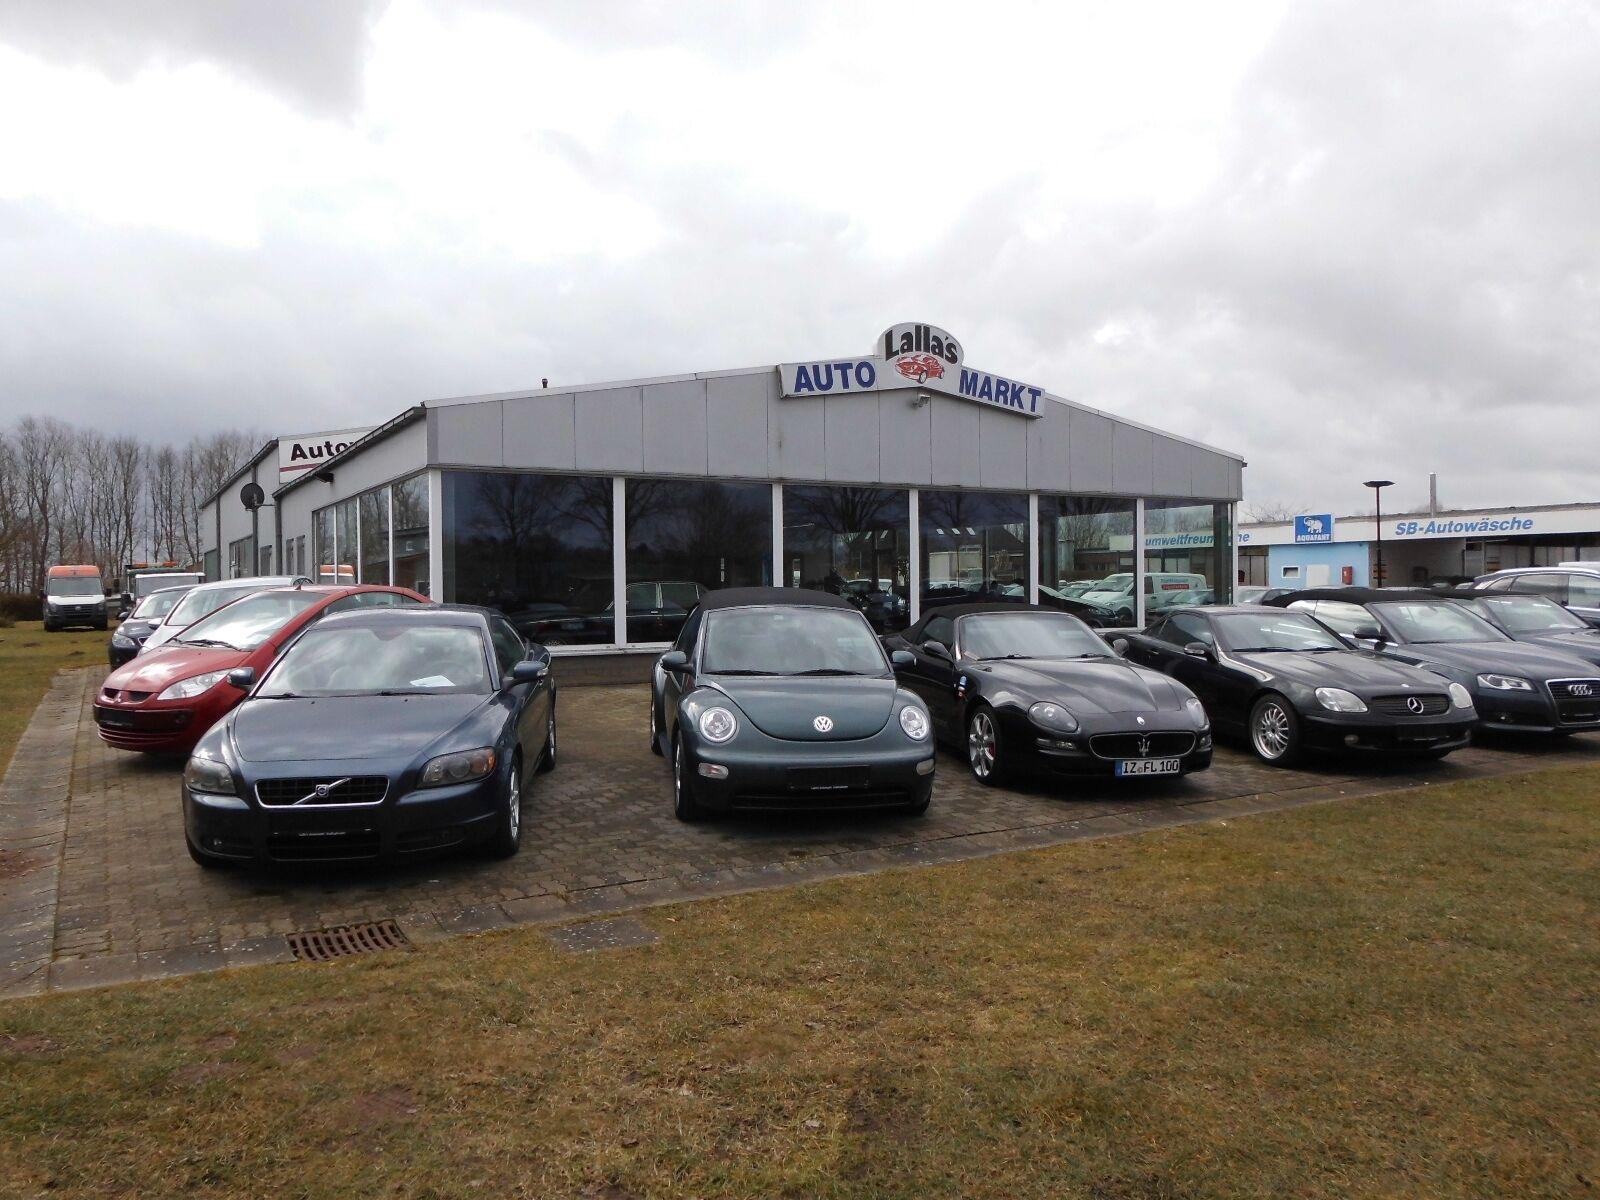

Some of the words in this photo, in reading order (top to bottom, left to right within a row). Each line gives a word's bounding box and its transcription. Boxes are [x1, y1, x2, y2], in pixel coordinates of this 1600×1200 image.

[884, 324, 958, 365] Lalla's
[794, 361, 876, 393] AUTO
[958, 369, 1042, 412] MARKT
[290, 440, 354, 461] Auto
[1395, 517, 1533, 536] SB-Autowäsche
[1124, 762, 1137, 774] IZ
[1143, 761, 1157, 773] FL
[1159, 760, 1179, 772] 100
